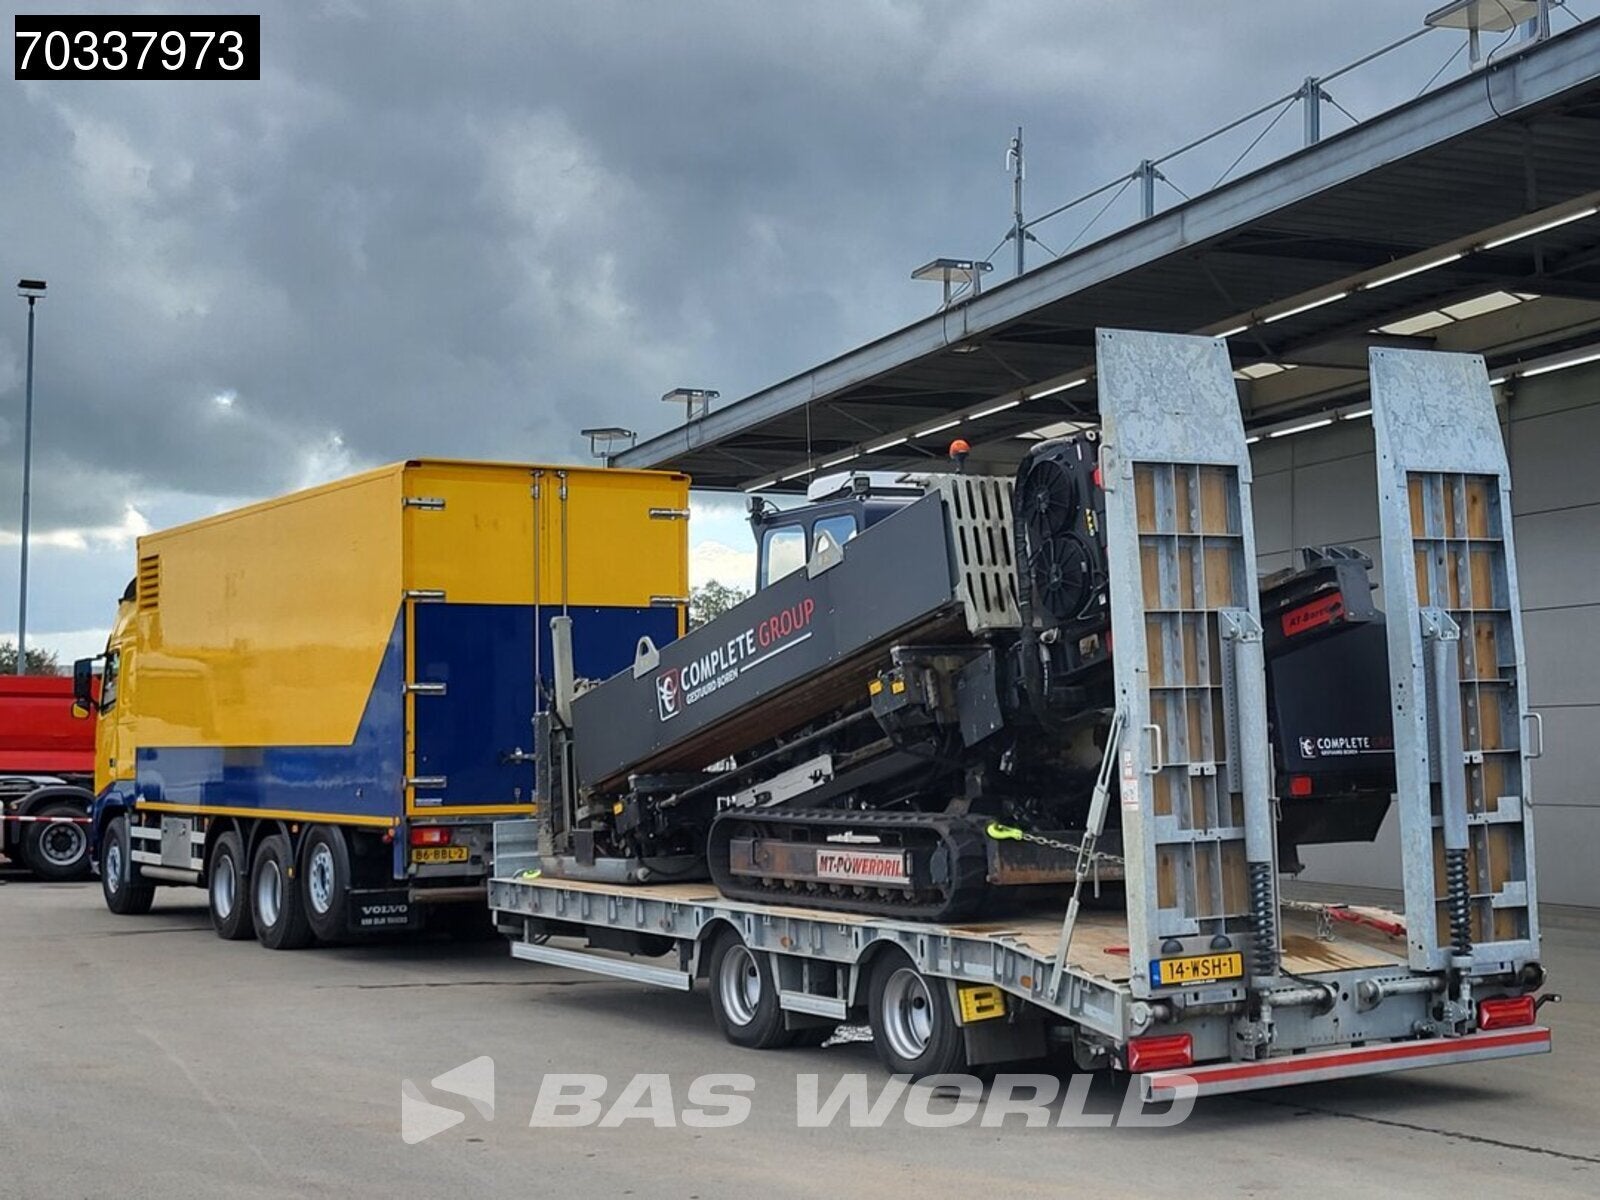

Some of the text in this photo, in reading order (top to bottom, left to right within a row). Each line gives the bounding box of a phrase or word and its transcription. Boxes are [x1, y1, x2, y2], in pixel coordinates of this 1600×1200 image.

[680, 598, 815, 691] COMPLETE GROUP
[1316, 737, 1371, 749] COMPLETE
[361, 904, 408, 915] VOLVO
[1168, 957, 1234, 979] 14-WSH-1
